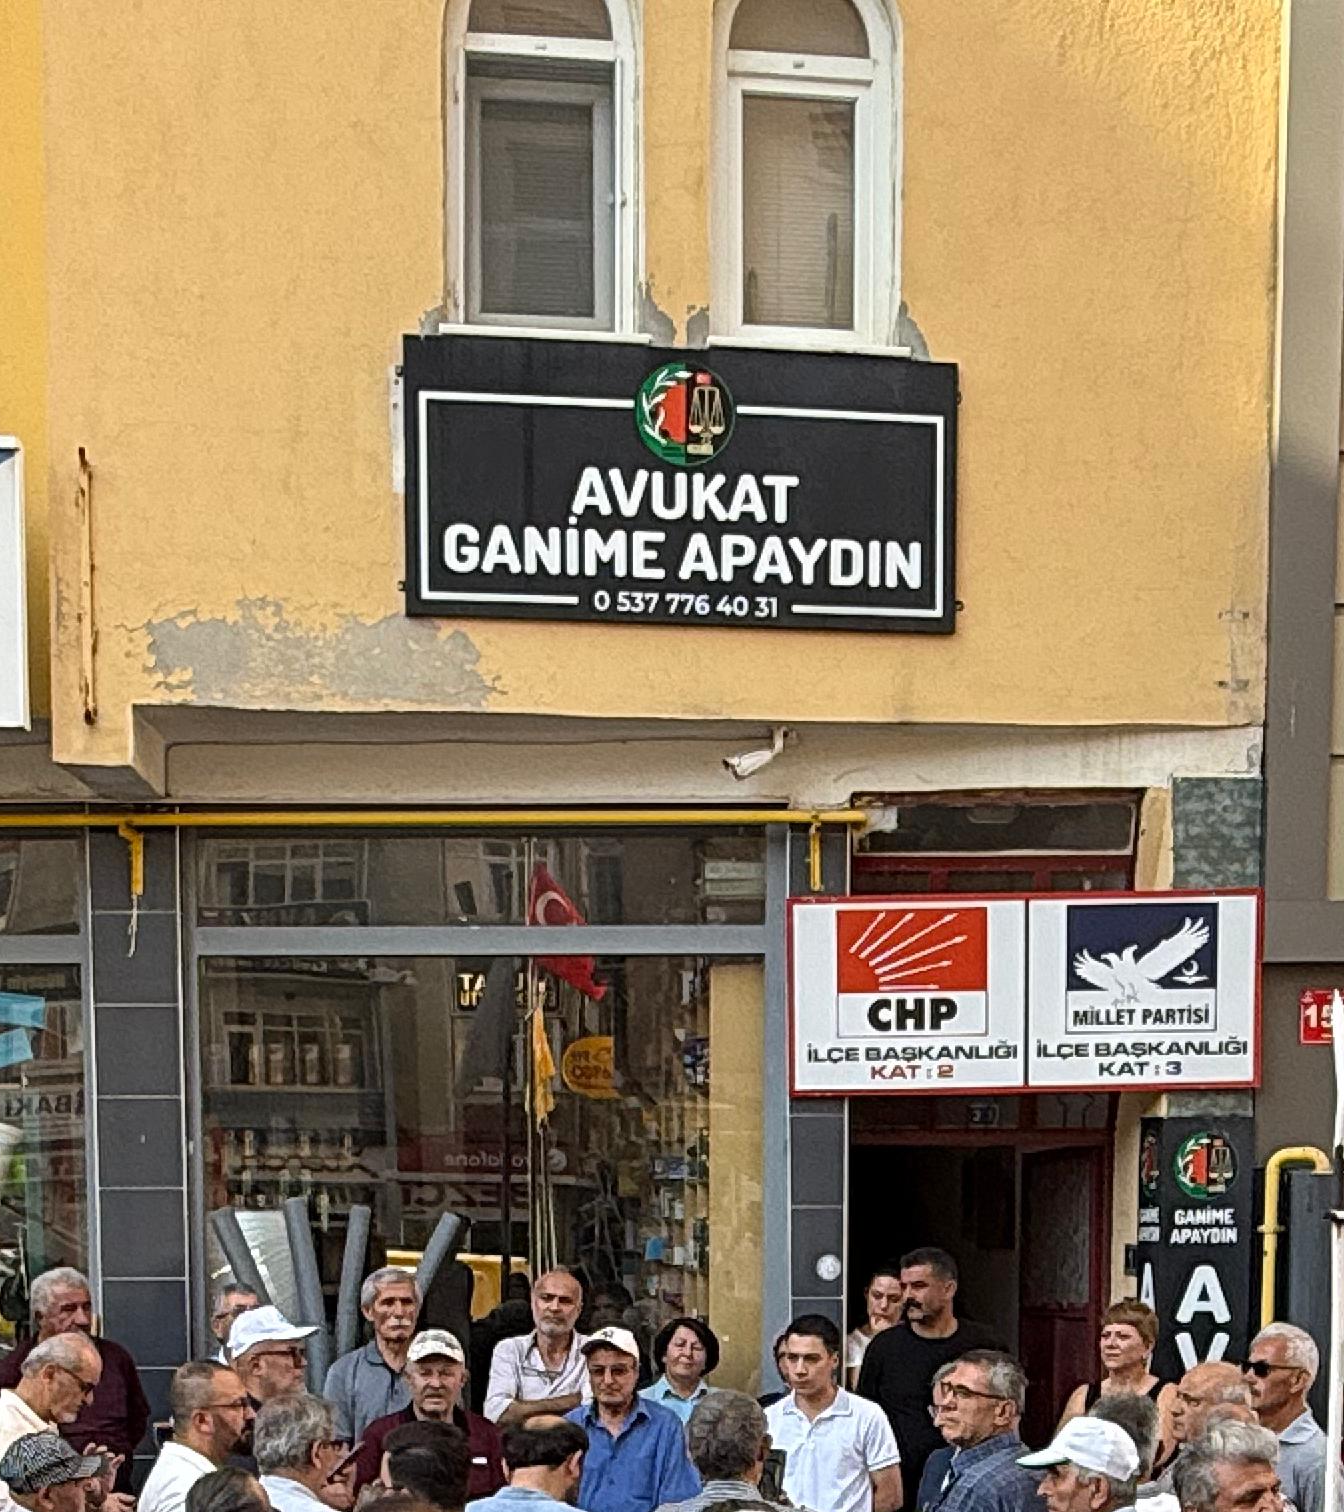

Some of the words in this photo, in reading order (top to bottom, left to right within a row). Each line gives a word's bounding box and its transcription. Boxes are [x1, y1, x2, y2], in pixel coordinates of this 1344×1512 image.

[572, 467, 799, 523] AVUKAT
[443, 514, 665, 580] GANİME
[679, 533, 923, 589] APAYDIN
[594, 590, 609, 611] 0
[616, 591, 659, 614] 537
[665, 593, 709, 616] 776
[716, 596, 749, 617] 40
[755, 596, 778, 618] 31
[867, 997, 958, 1032] CHP
[1073, 1004, 1136, 1028] MİLLET
[1141, 1003, 1210, 1026] PARTİSİ
[806, 1042, 861, 1065] İLÇE
[865, 1038, 1018, 1064] BAŞKANLIĞI
[1036, 1039, 1089, 1060] İLÇE
[1094, 1035, 1248, 1059] BAŞKANLIĞI
[871, 1065, 921, 1080] KAT
[937, 1064, 954, 1079] 2
[1098, 1061, 1147, 1077] KAT
[1166, 1060, 1183, 1076] 3
[1174, 1205, 1235, 1226] GANİME
[1170, 1226, 1238, 1244] APAYDIN
